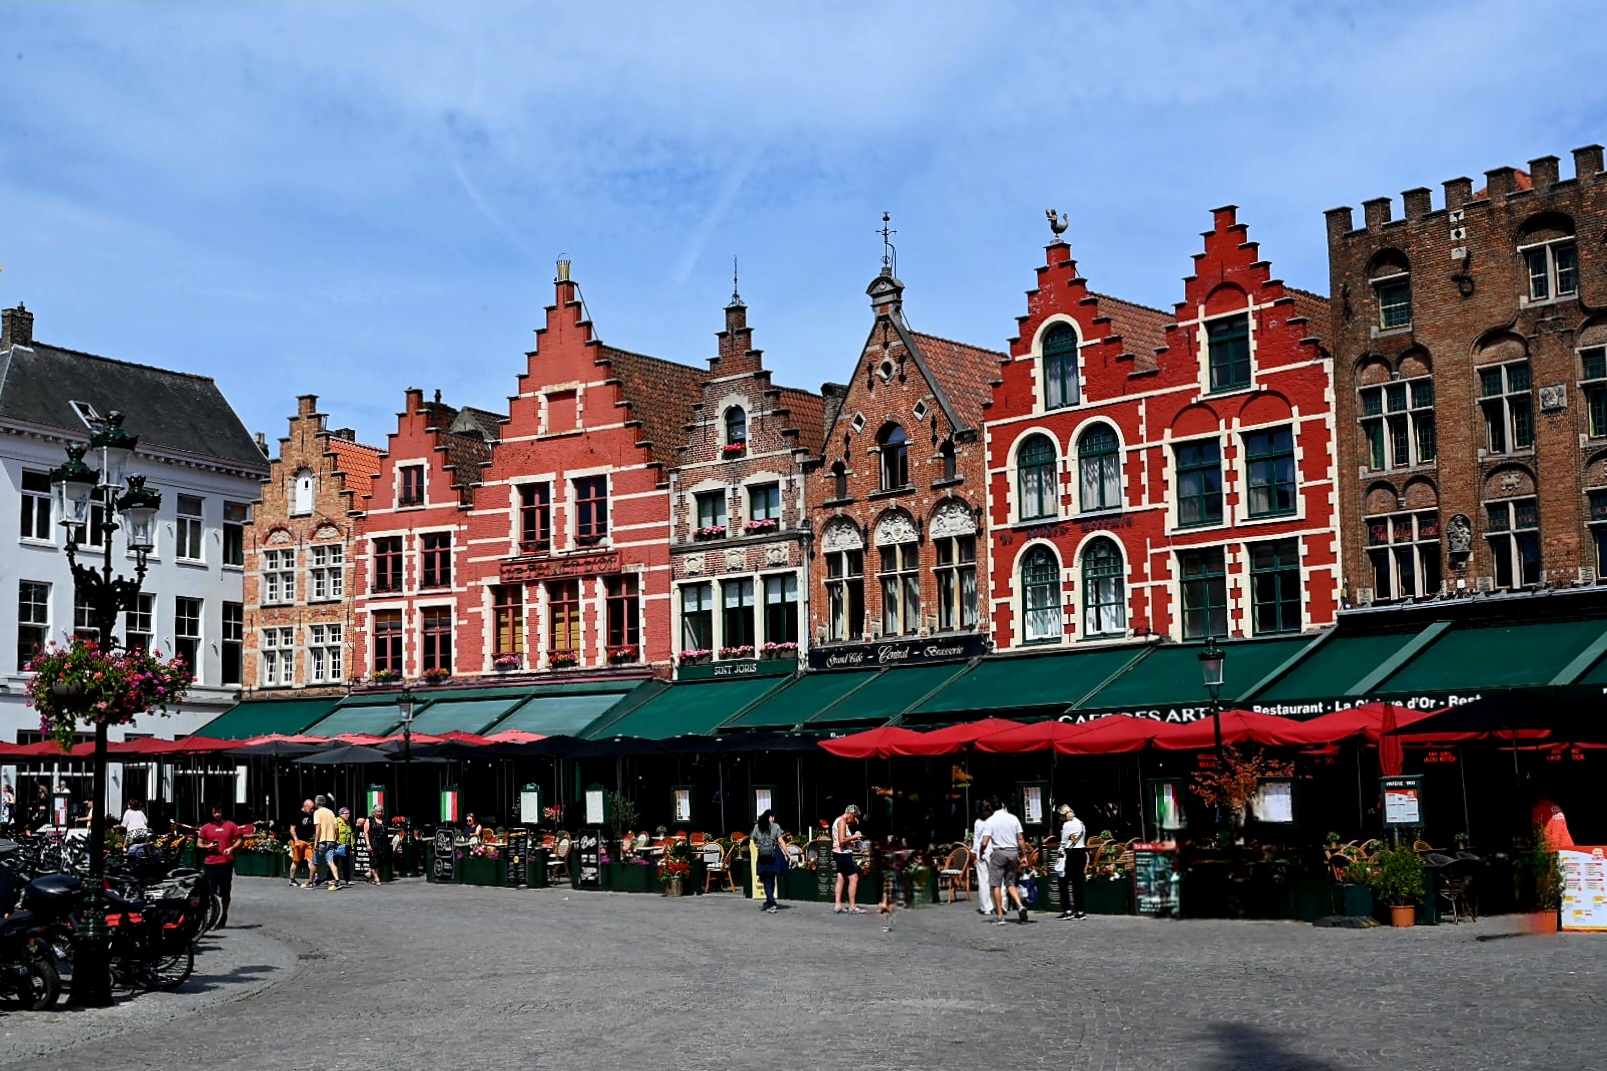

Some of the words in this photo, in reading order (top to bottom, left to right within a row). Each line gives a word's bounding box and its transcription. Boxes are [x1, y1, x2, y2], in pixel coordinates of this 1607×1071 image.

[877, 645, 910, 664] Central
[923, 645, 964, 658] Brasserie
[714, 665, 733, 676] SINT
[734, 663, 757, 674] JORIS
[1253, 701, 1324, 716] Restaurant
[1335, 700, 1352, 713] La
[1407, 696, 1437, 709] d'Or
[1058, 713, 1112, 725] CA
